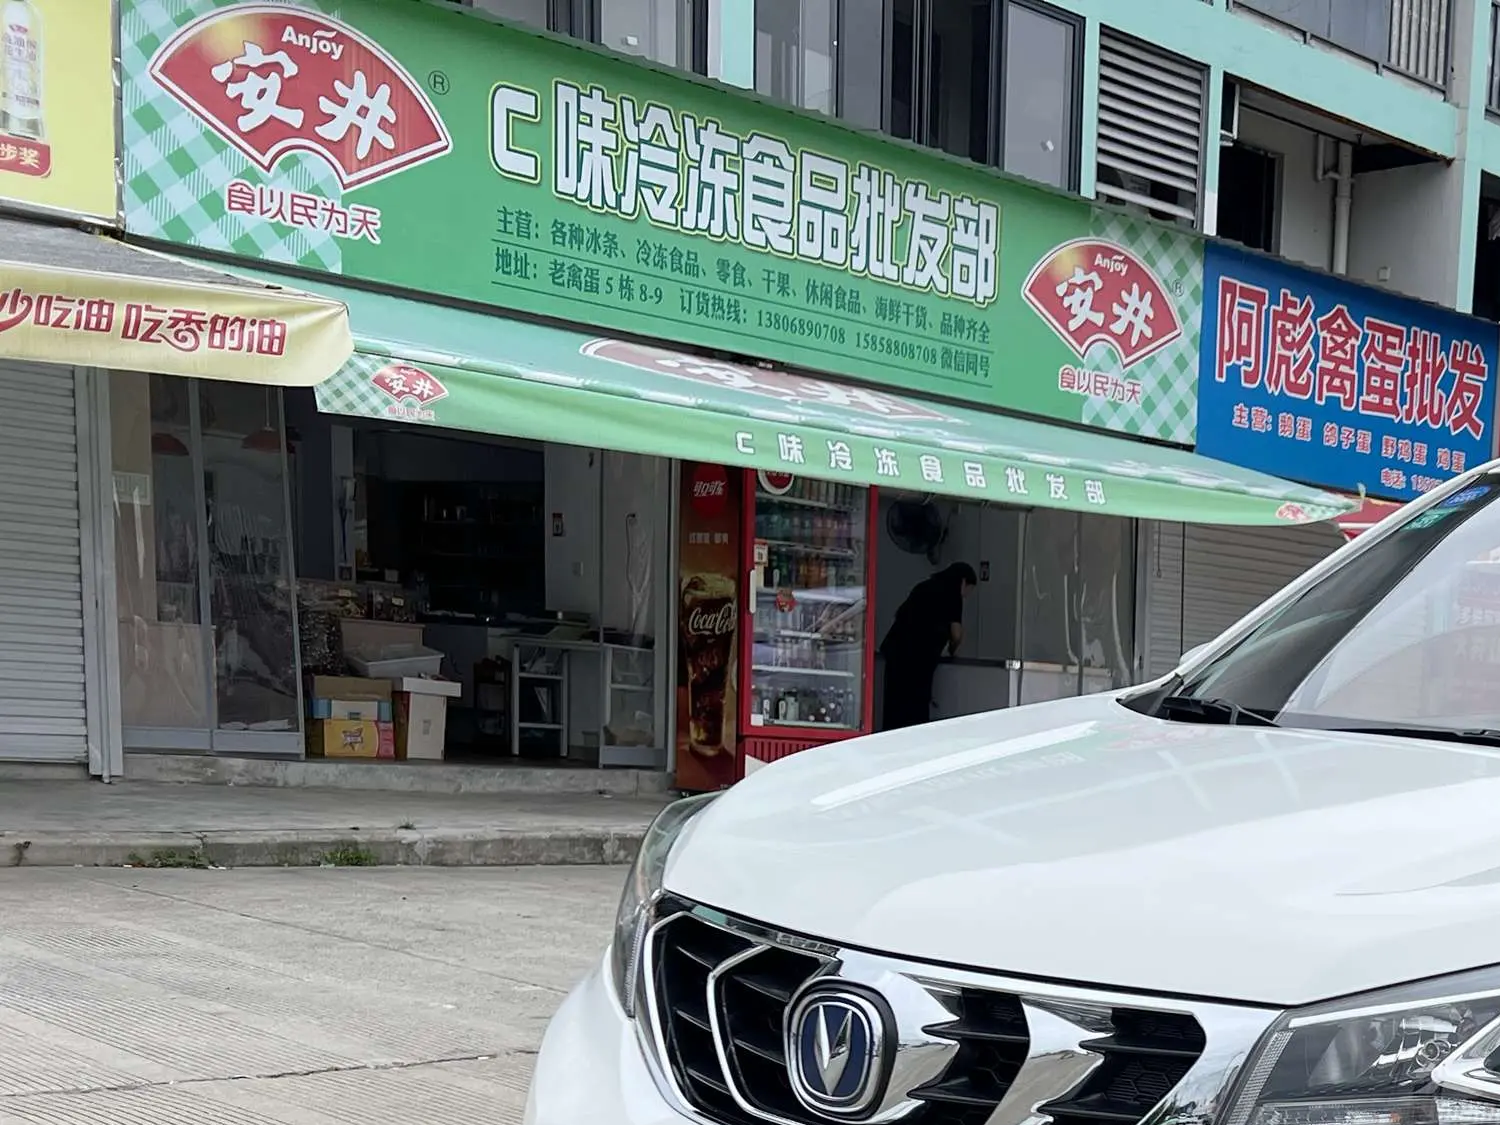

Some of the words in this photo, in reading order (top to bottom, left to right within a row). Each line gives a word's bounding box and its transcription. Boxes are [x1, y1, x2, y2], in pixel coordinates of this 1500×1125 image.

[282, 26, 344, 60] Anjoy
[211, 41, 397, 160] 安井
[228, 181, 381, 243] 食以民为天
[1094, 253, 1129, 276] Anjoy
[121, 303, 288, 356] 吃香的油
[1055, 267, 1154, 348] 安井
[1214, 276, 1489, 438] 阿彪禽蛋批发
[1060, 367, 1142, 405] 食以民为天
